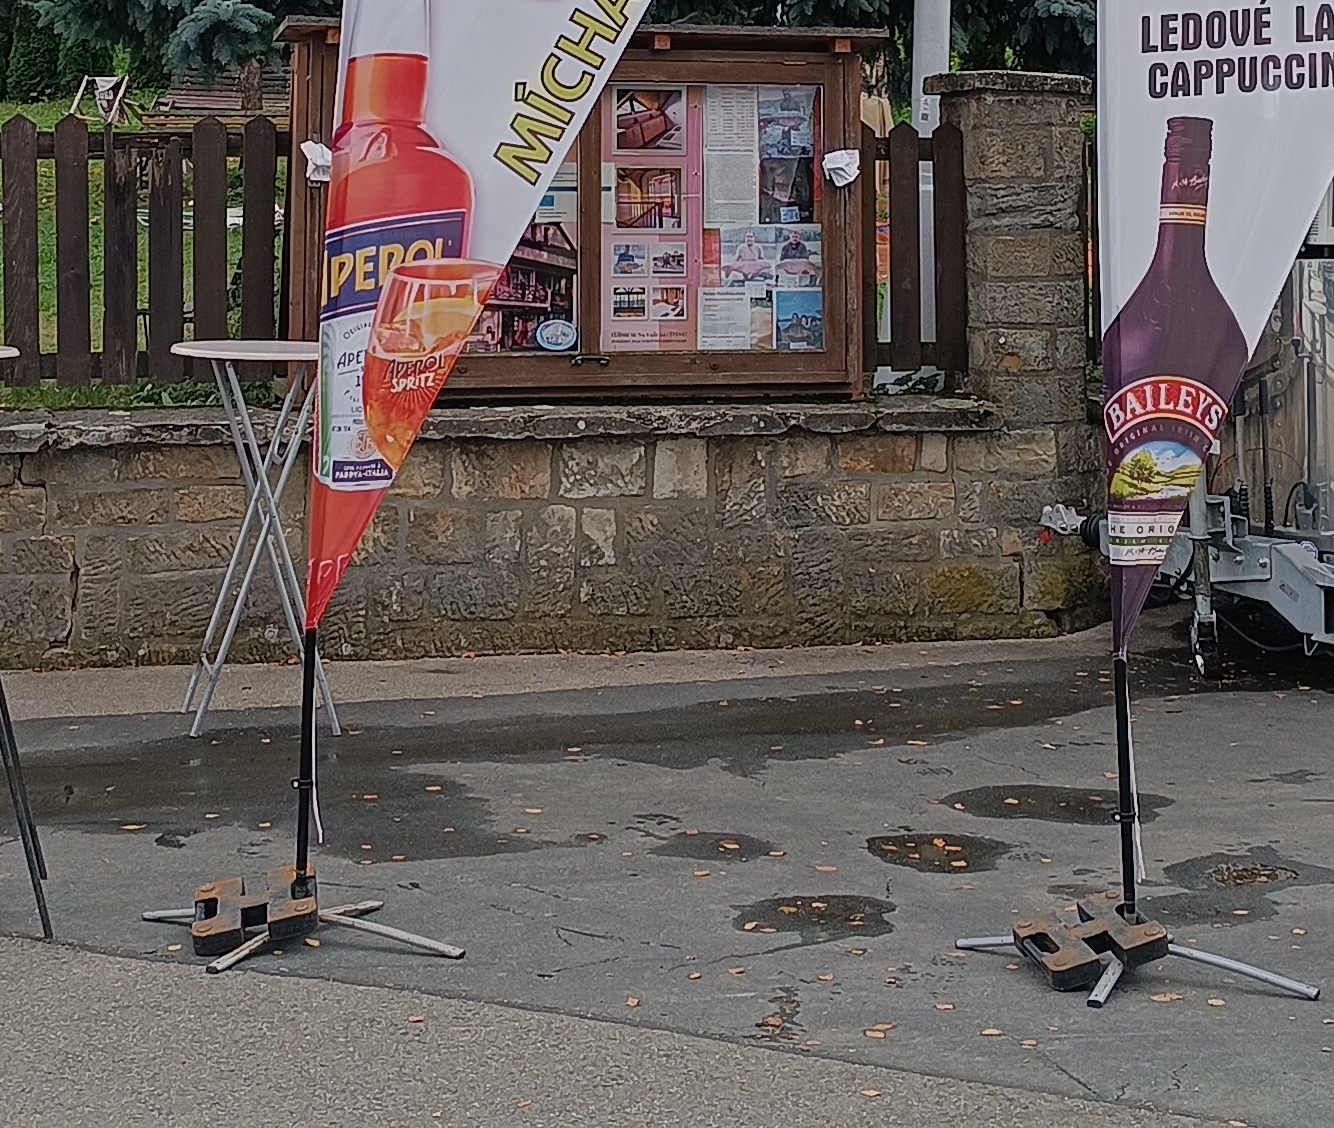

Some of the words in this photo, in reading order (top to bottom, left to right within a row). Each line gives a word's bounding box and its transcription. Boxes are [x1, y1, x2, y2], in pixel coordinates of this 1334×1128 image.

[384, 352, 446, 382] APEROL
[391, 372, 436, 393] SPRITZ
[1108, 383, 1223, 430] BAILEYS
